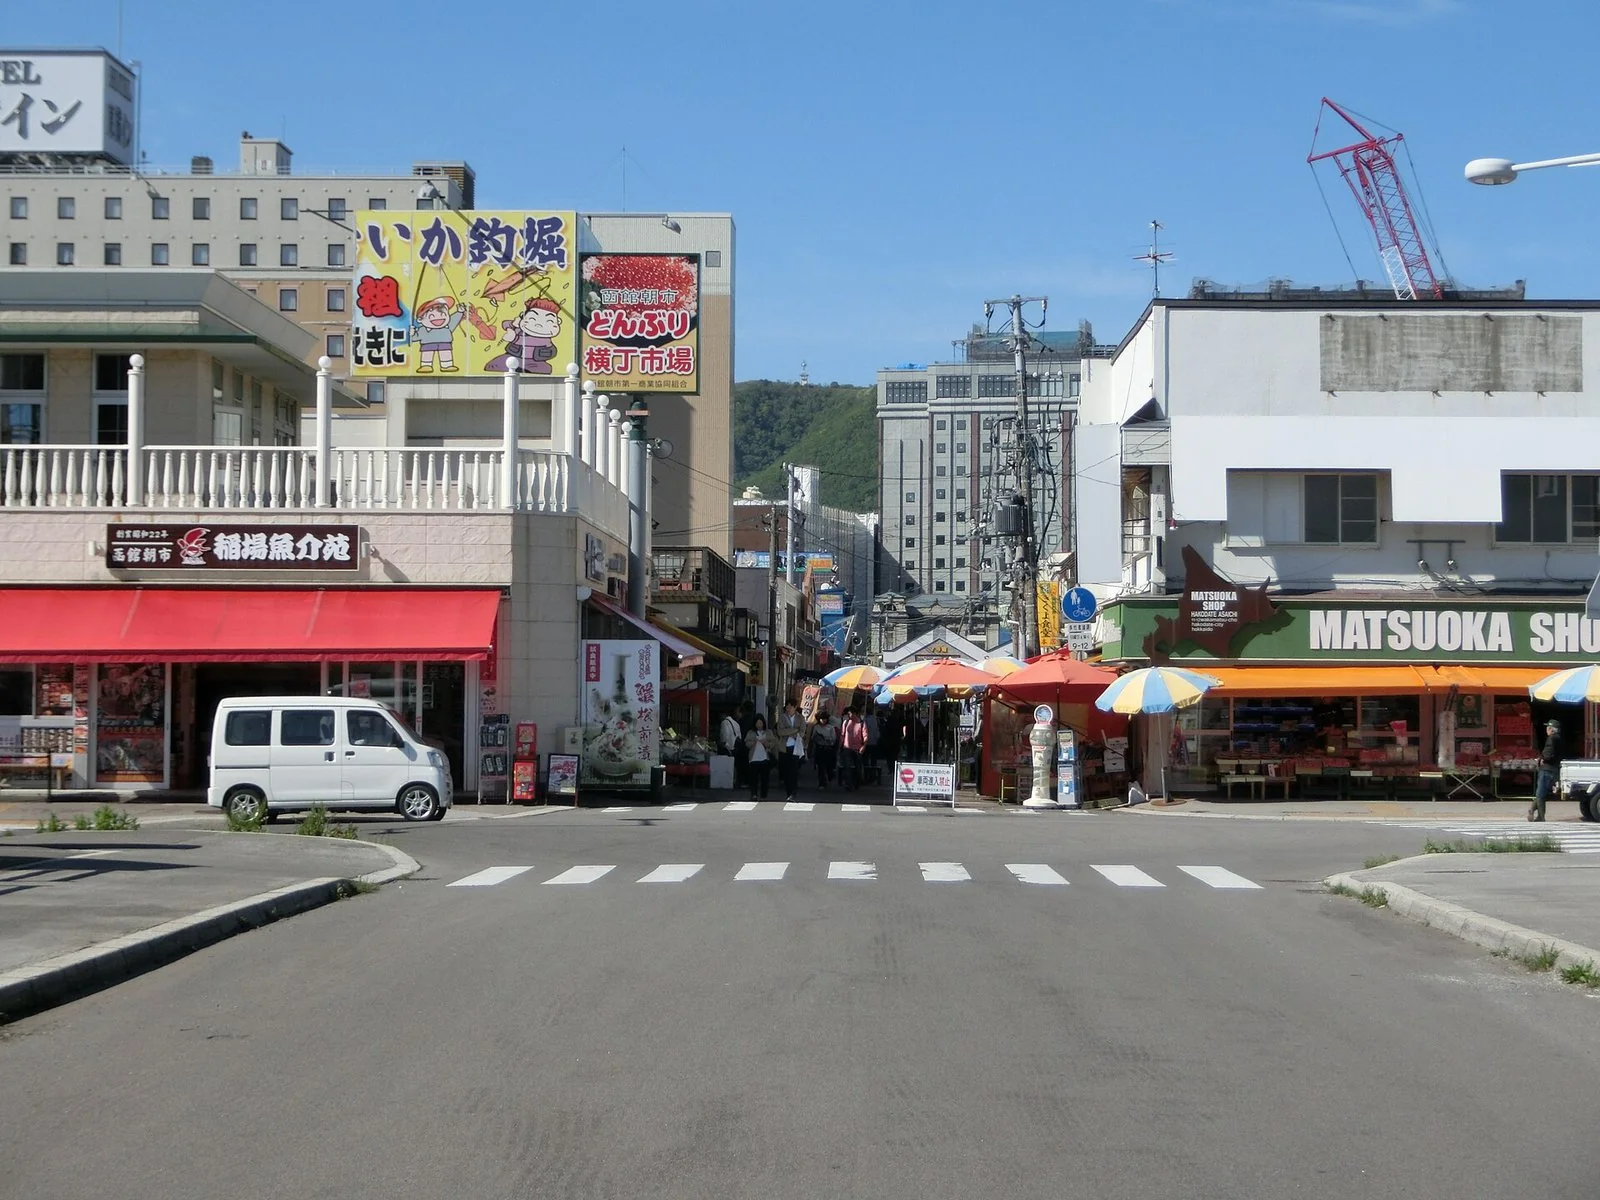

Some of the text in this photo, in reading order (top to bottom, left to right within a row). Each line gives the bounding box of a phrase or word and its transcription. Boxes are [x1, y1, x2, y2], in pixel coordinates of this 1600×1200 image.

[0, 60, 42, 84] EL
[357, 216, 566, 270] いか釣堀
[600, 288, 678, 305] 函館朝市
[587, 310, 690, 339] どんぶり
[584, 346, 694, 375] 横丁市場
[593, 380, 688, 388] 館朝市第一商業協同組合
[1191, 591, 1237, 600] MATSUOKA
[1202, 601, 1226, 610] SHOP
[1309, 610, 1513, 651] MATSUOKA
[917, 776, 951, 787] 車両進入禁止
